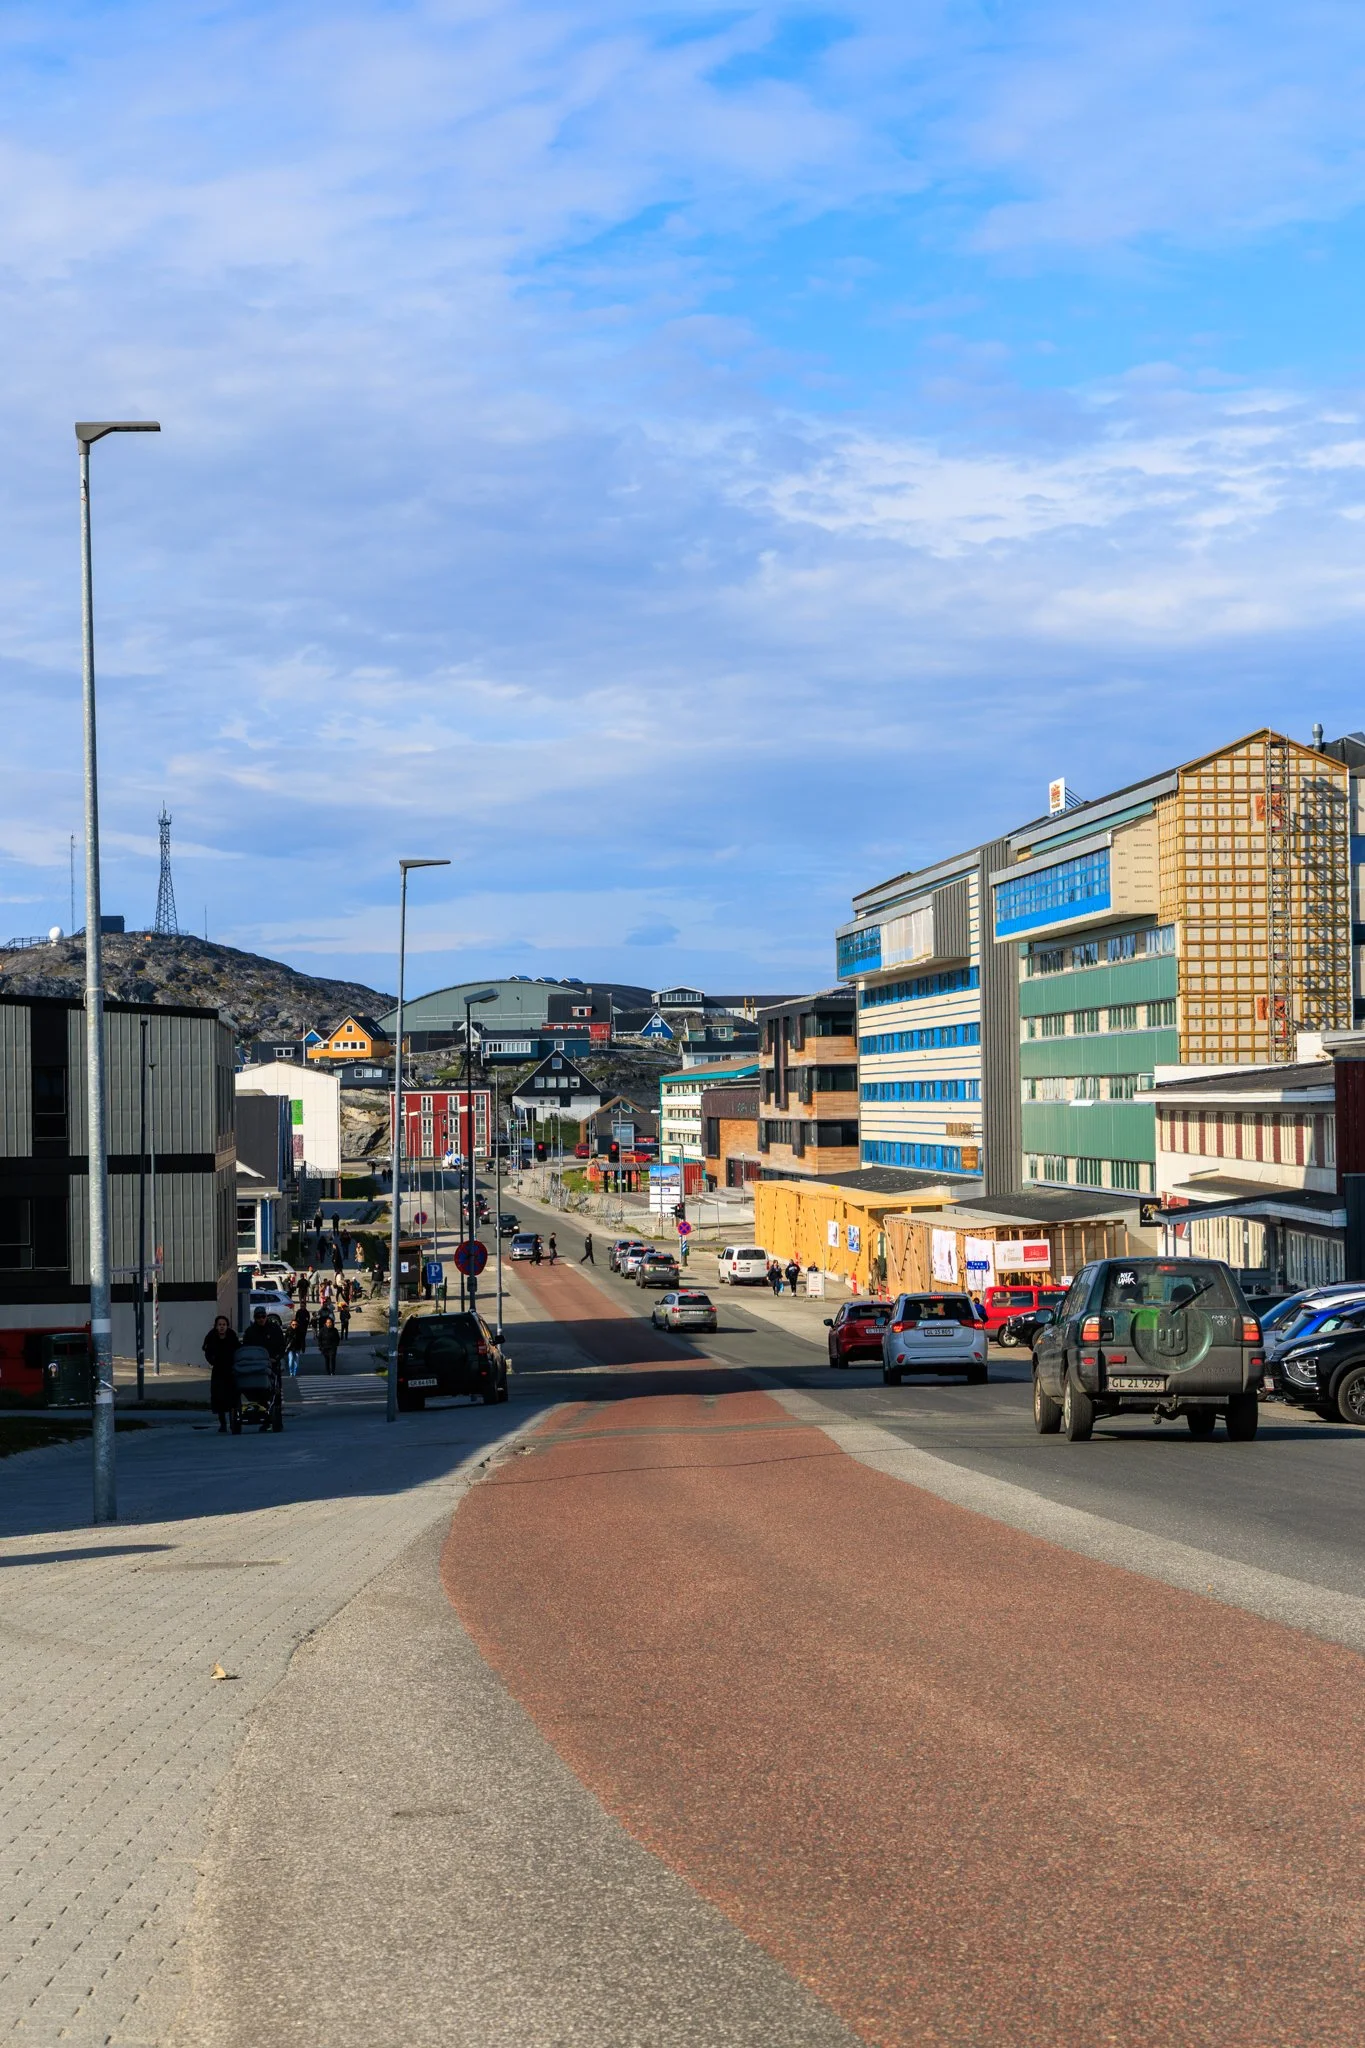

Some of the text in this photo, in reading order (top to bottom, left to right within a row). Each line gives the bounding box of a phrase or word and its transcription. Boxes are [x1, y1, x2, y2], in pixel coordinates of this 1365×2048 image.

[430, 1265, 440, 1277] P
[1112, 1378, 1160, 1388] GL 21 929
